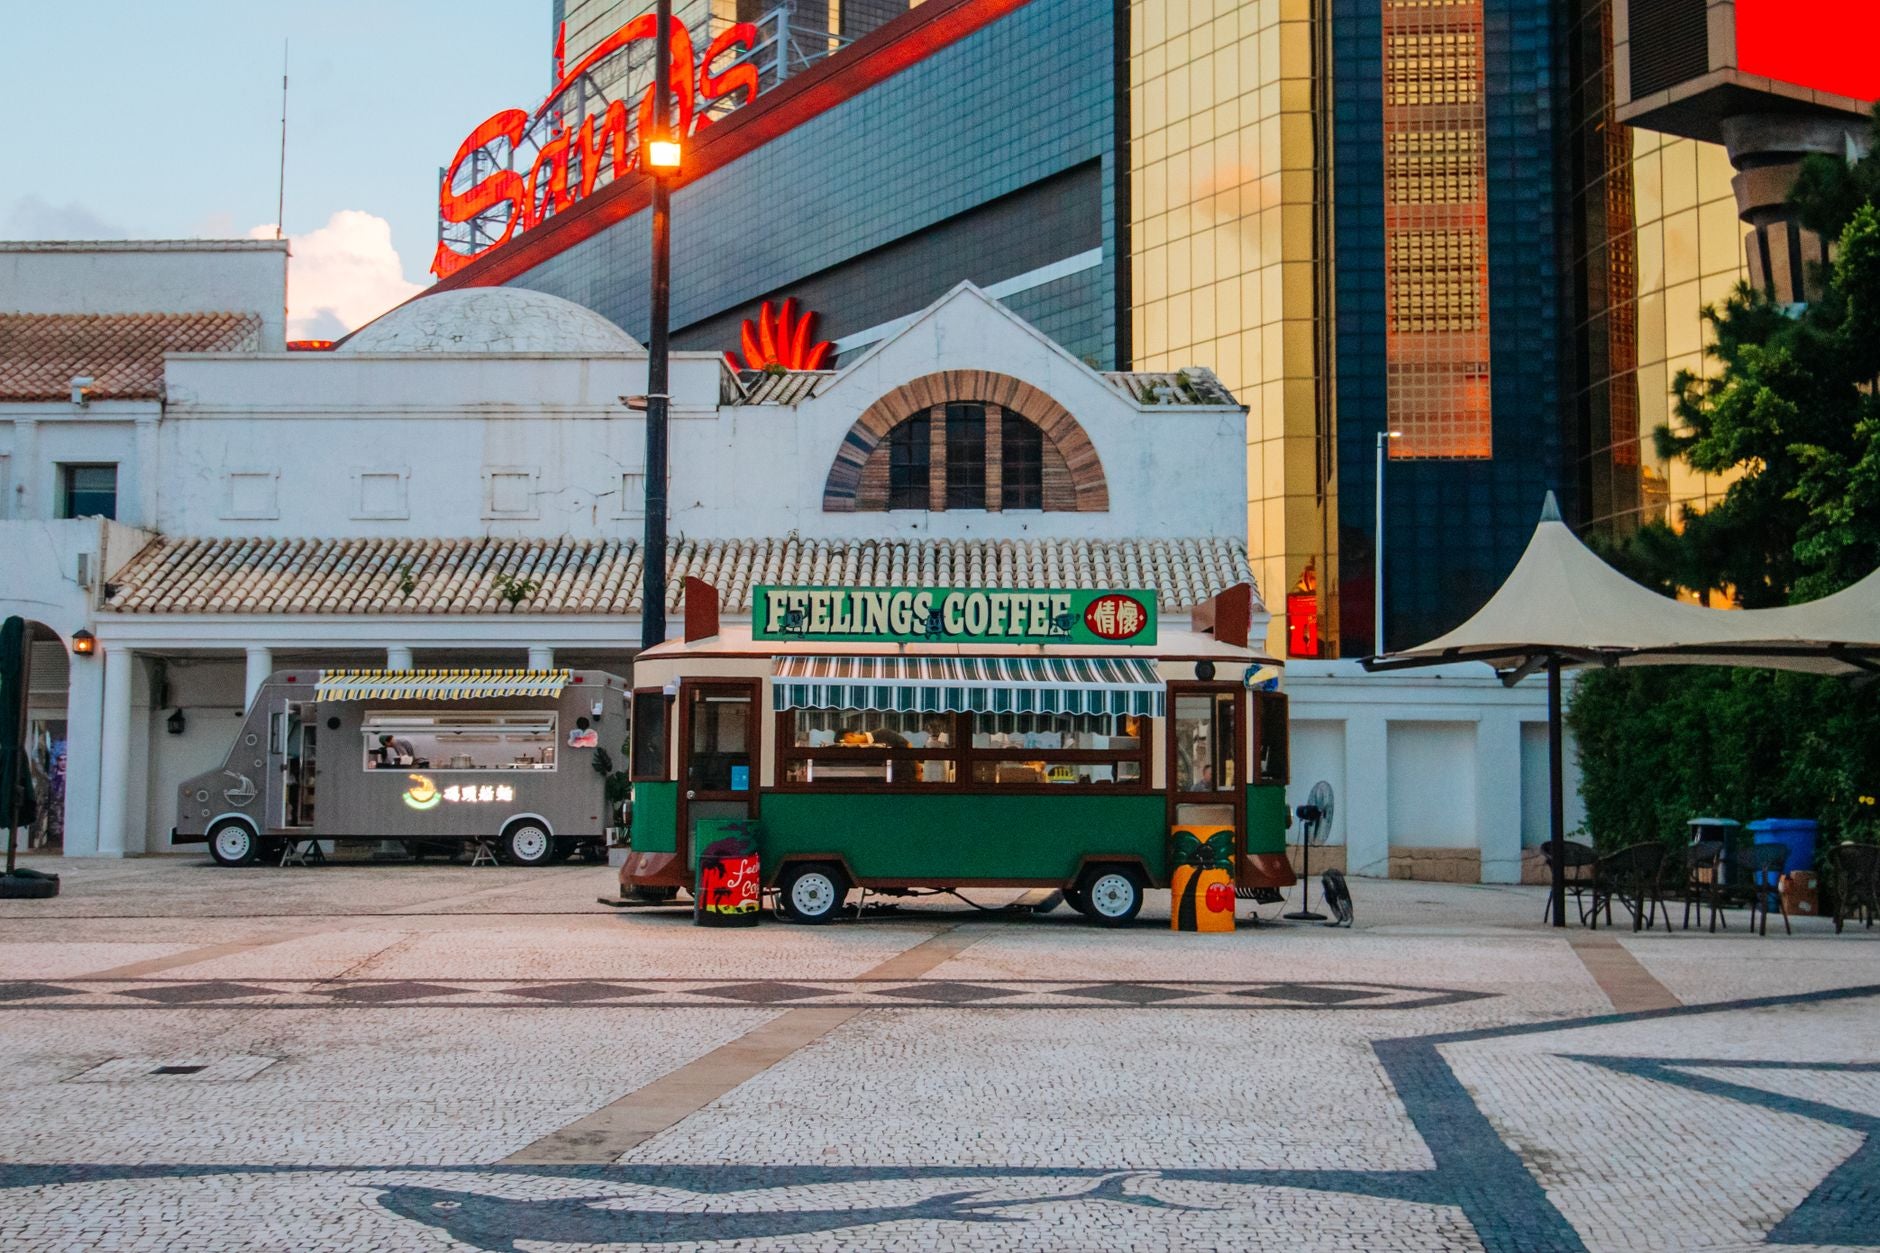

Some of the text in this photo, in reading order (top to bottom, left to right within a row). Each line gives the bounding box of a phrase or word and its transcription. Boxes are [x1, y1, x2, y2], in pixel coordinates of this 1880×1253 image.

[430, 14, 759, 280] Sands
[765, 591, 1072, 637] FEELINGS COFFEE
[1093, 600, 1138, 635] 情懷
